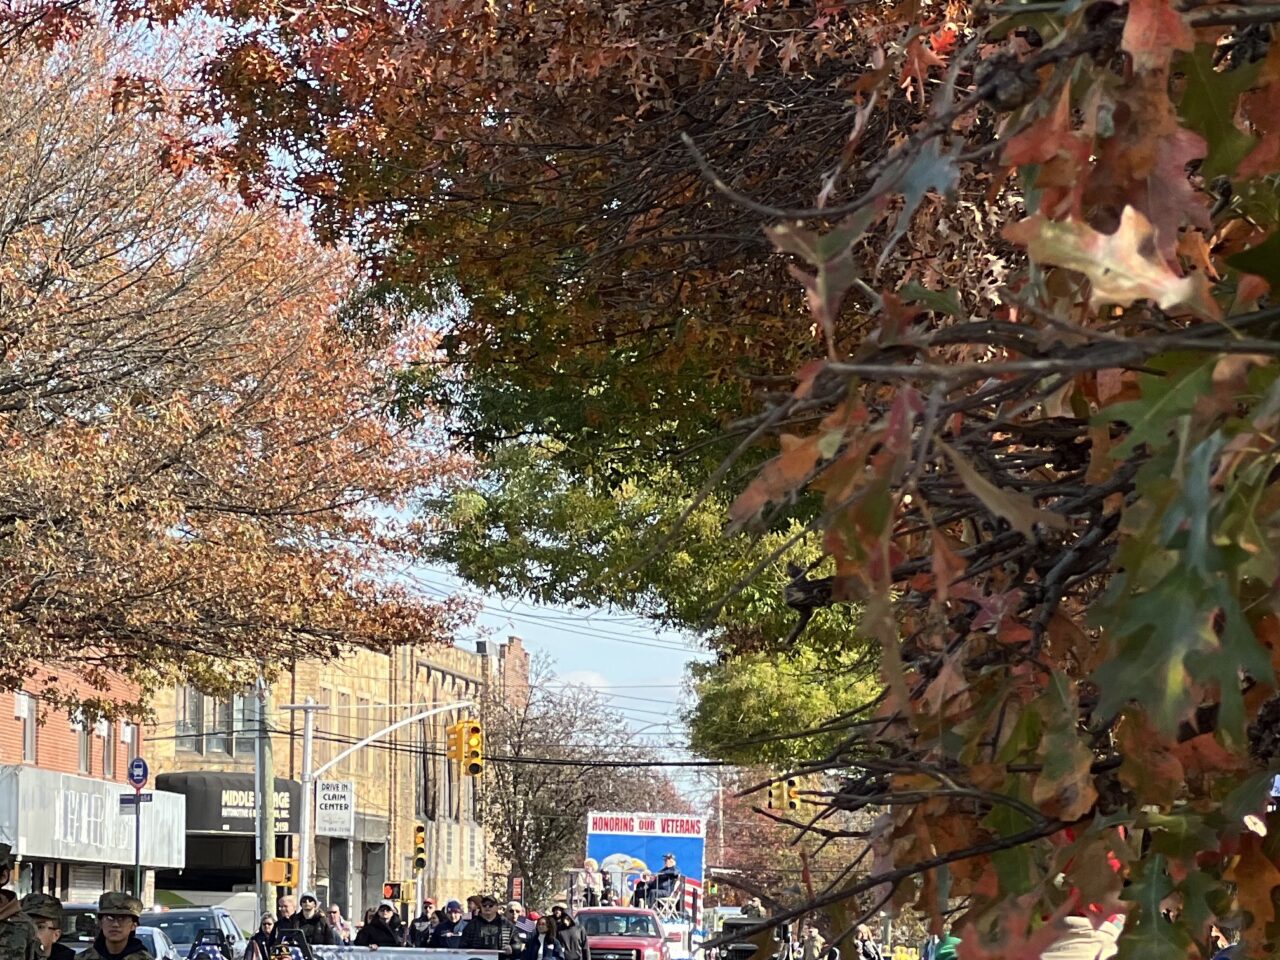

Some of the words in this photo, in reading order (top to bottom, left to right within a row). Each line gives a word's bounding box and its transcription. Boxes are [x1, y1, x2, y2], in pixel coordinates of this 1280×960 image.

[321, 783, 340, 791] DRIVE
[341, 784, 348, 792] IN
[221, 790, 255, 807] MIDDLE
[322, 793, 347, 801] CLAIM
[319, 803, 350, 811] CENTER
[592, 816, 634, 832] HONORING
[638, 820, 656, 831] OUR
[660, 818, 701, 835] VETERANS
